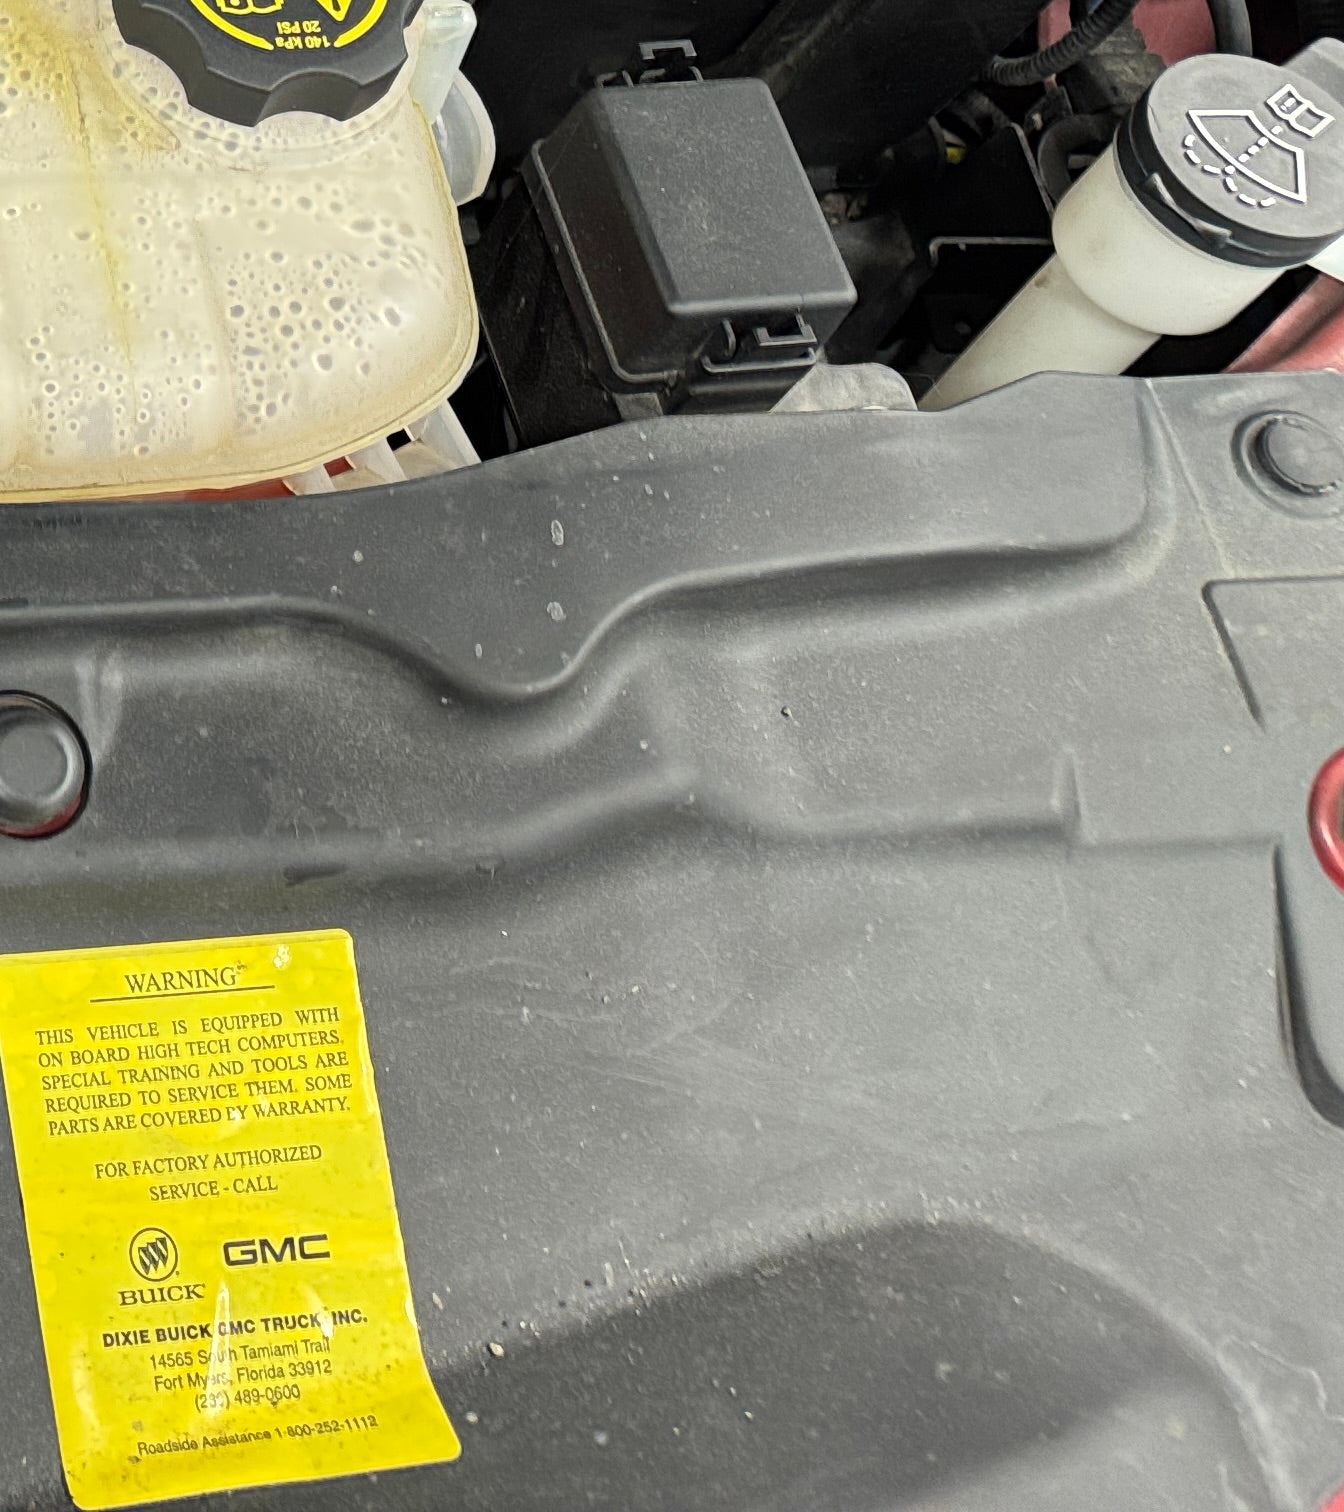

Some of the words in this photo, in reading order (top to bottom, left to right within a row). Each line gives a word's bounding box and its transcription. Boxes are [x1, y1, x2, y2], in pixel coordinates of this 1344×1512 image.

[276, 36, 303, 49] kPa
[277, 21, 301, 34] PSI
[304, 20, 320, 33] 20
[304, 36, 330, 48] 140
[124, 966, 237, 994] WARNING
[35, 1029, 73, 1045] THIS
[87, 1022, 159, 1042] VEHICLE
[172, 1020, 187, 1035] IS
[200, 1013, 282, 1034] EQUIPPED
[295, 1007, 339, 1024] WITH
[39, 1052, 63, 1067] ON
[70, 1047, 130, 1065] BOARD
[137, 1043, 179, 1060] HIGH
[186, 1039, 231, 1056] TECH
[238, 1030, 344, 1052] COMPUTERS.
[42, 1071, 111, 1090] SPECIAL
[118, 1064, 199, 1084] TRAINING
[208, 1061, 244, 1077] AND
[252, 1055, 307, 1073] TOOLS
[316, 1052, 349, 1068] ARE
[45, 1092, 131, 1113] REQUIRED
[138, 1090, 161, 1105] TO
[168, 1083, 238, 1103] SERVICE
[244, 1079, 297, 1097] THEM.
[306, 1074, 352, 1091] SOME
[49, 1118, 99, 1135] PARTS
[103, 1115, 137, 1131] ARE
[140, 1108, 221, 1128] COVERED
[252, 1097, 350, 1118] WARRANTY.
[95, 1163, 129, 1178] FOR
[133, 1155, 209, 1175] FACTORY
[213, 1145, 322, 1169] AUTHORIZED
[149, 1181, 219, 1201] SERVICE
[233, 1176, 277, 1193] CALL
[224, 1234, 330, 1266] GMC
[118, 1283, 205, 1306] BUICK
[103, 1330, 150, 1347] DIXIE
[155, 1323, 212, 1342] BUICK
[217, 1319, 256, 1336] GMC
[332, 1308, 368, 1325] INC.
[150, 1352, 193, 1370] 14565
[240, 1340, 299, 1360] Tamiami
[301, 1337, 330, 1353] Trail
[154, 1375, 183, 1391] Fort
[237, 1365, 285, 1383] Florida
[289, 1359, 331, 1376] 33912
[234, 1384, 300, 1404] 489-0600
[138, 1440, 198, 1456] Roadside
[203, 1429, 272, 1448] Assistance
